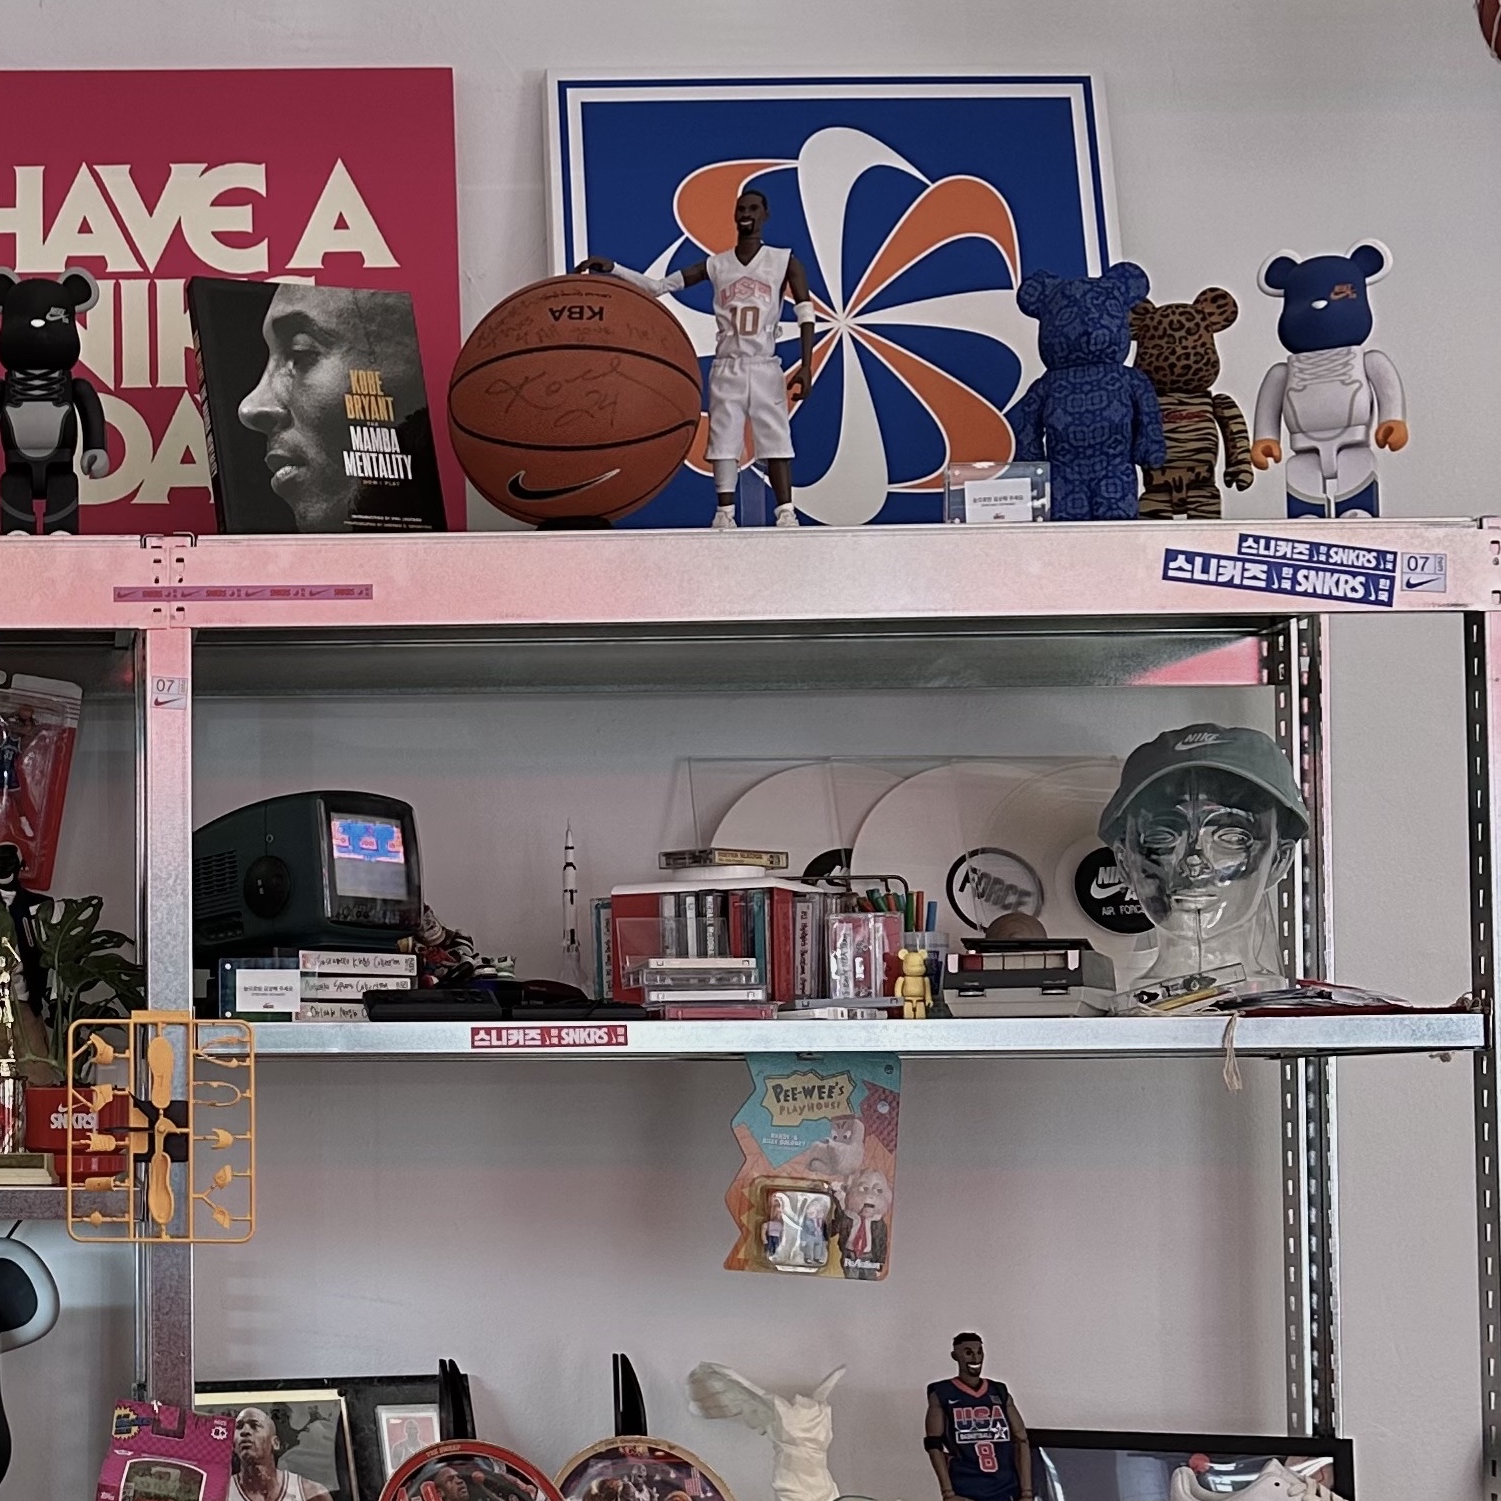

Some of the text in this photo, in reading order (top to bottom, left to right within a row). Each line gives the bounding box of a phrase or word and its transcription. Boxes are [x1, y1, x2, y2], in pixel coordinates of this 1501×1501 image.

[286, 157, 400, 269] A
[719, 276, 772, 306] USA
[549, 306, 604, 322] KBA
[729, 305, 759, 337] 10
[349, 369, 384, 395] KOBE
[344, 394, 395, 421] BRYANT
[349, 425, 401, 453] MAMBA
[342, 450, 413, 480] MENTALITY
[1241, 537, 1309, 559] 스니커즈
[1328, 547, 1377, 568] SNKRS
[1407, 555, 1430, 572] 07
[1167, 554, 1268, 588] 스니커즈
[1296, 569, 1366, 599] SNKRS
[156, 679, 175, 692] 07
[474, 1029, 541, 1046] 스니커즈
[560, 1027, 608, 1045] SNKRS
[50, 1112, 97, 1129] SNKRS
[954, 1405, 1009, 1431] USA
[976, 1442, 998, 1473] 8
